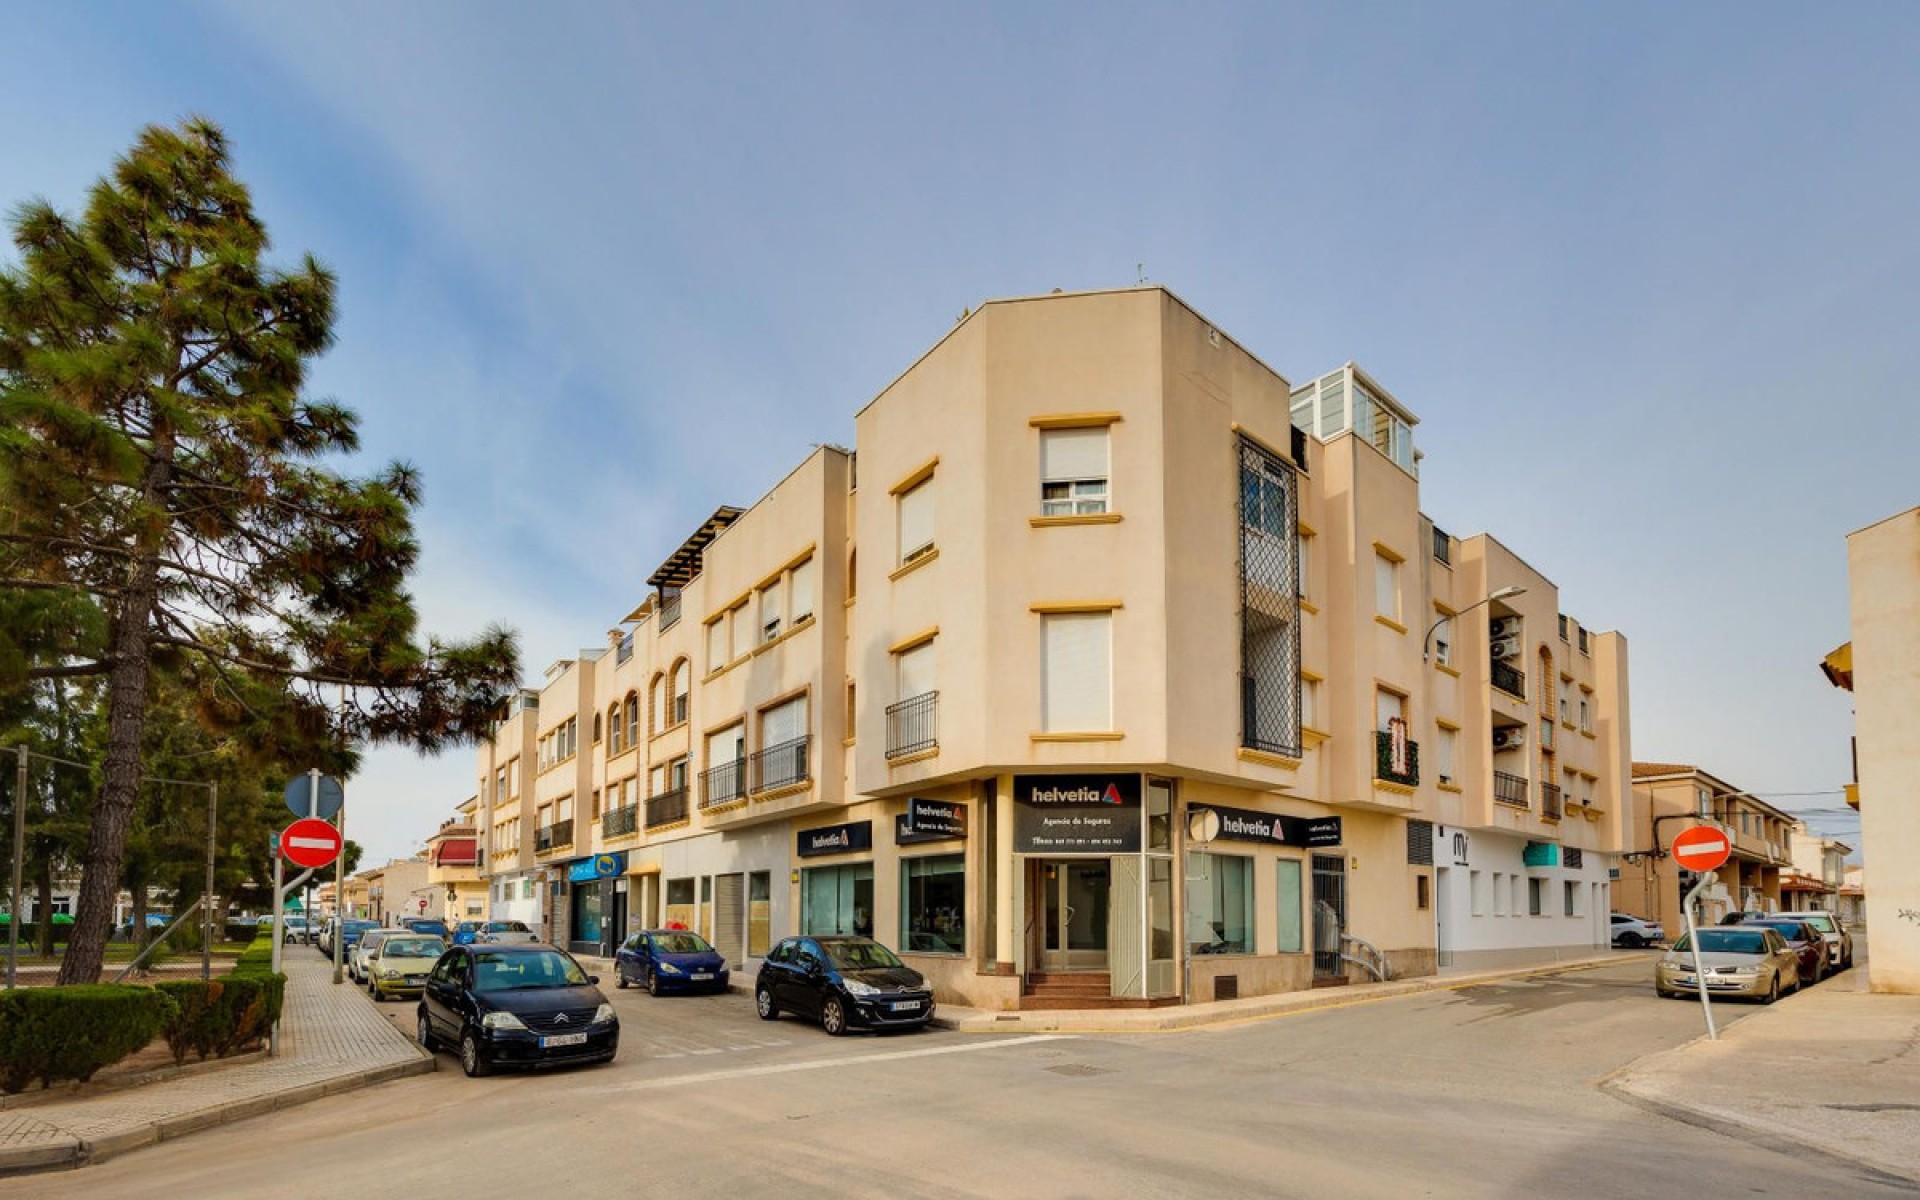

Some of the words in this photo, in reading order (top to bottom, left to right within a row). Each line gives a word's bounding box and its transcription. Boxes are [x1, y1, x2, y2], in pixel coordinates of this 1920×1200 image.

[1031, 786, 1099, 802] helvetia
[916, 804, 953, 818] helvetia
[1223, 815, 1270, 836] helvetia
[812, 832, 840, 849] helvetia
